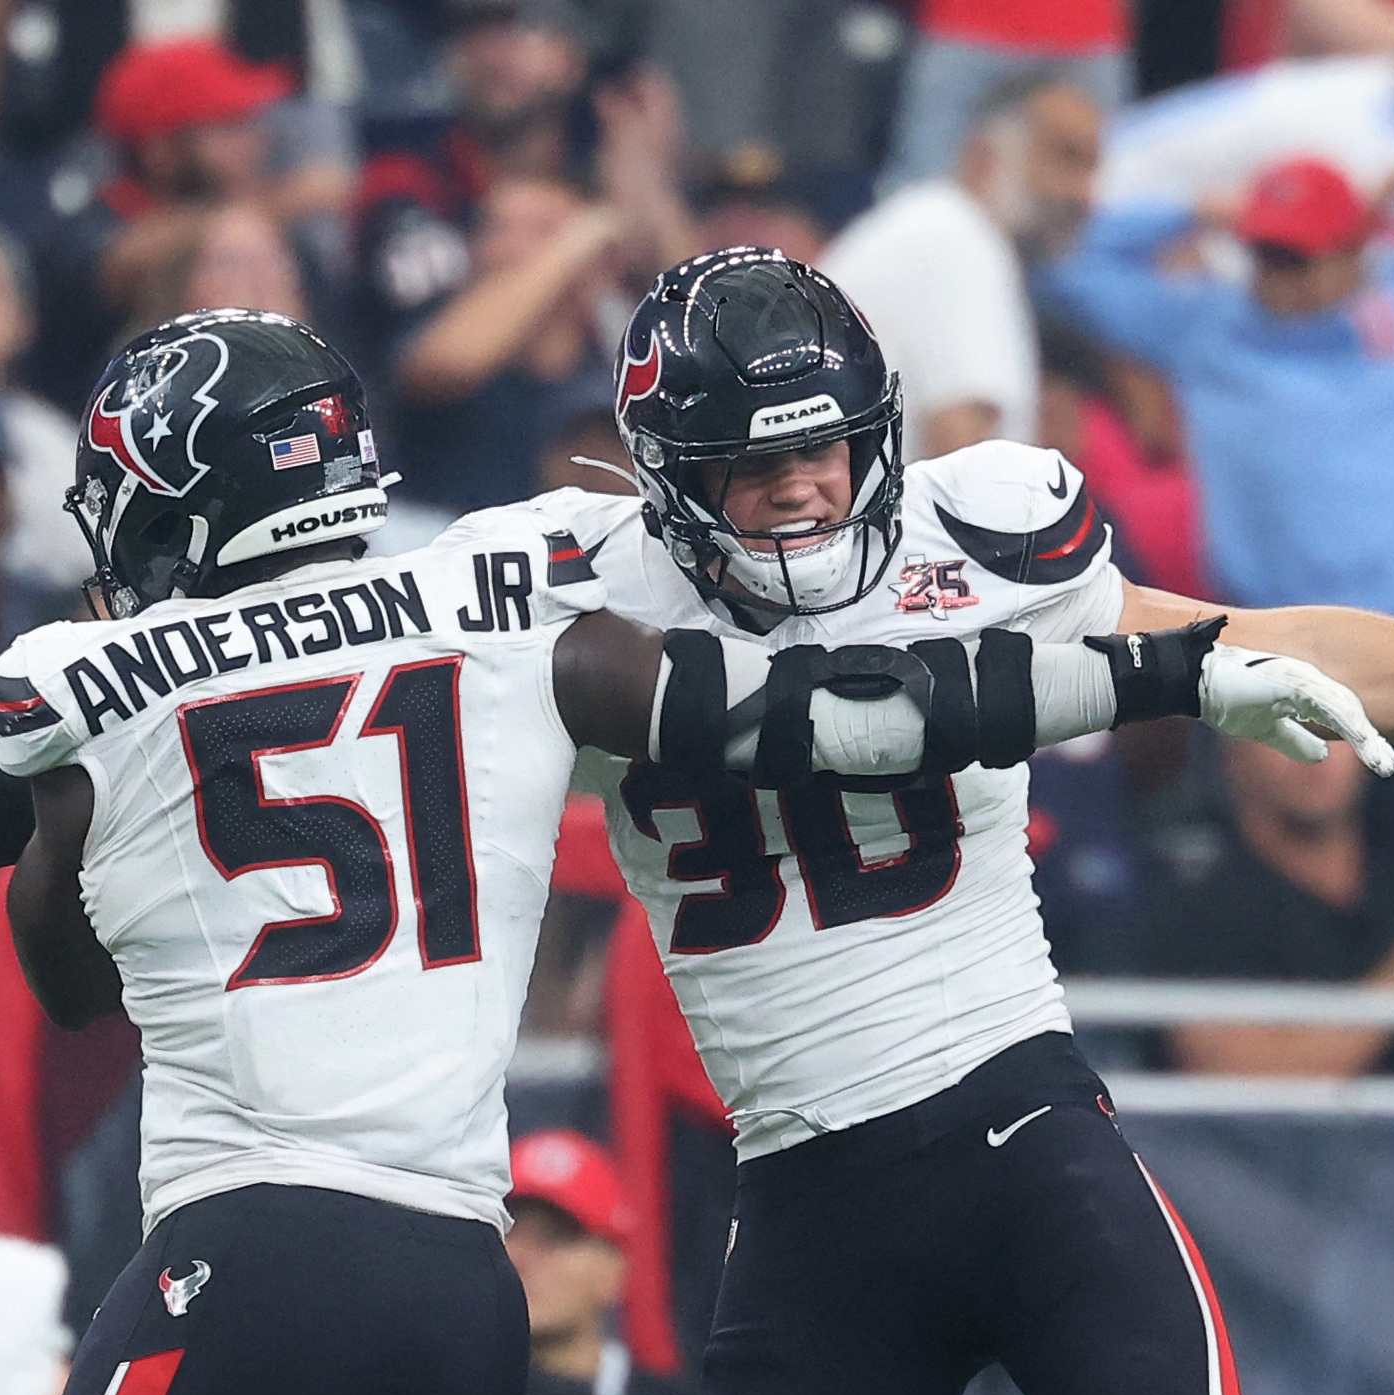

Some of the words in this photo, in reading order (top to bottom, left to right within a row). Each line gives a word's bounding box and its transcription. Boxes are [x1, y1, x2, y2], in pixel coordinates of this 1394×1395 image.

[759, 402, 832, 426] TEXANS
[63, 570, 433, 736] ANDERSON
[457, 551, 533, 632] JR
[176, 652, 483, 993] 51
